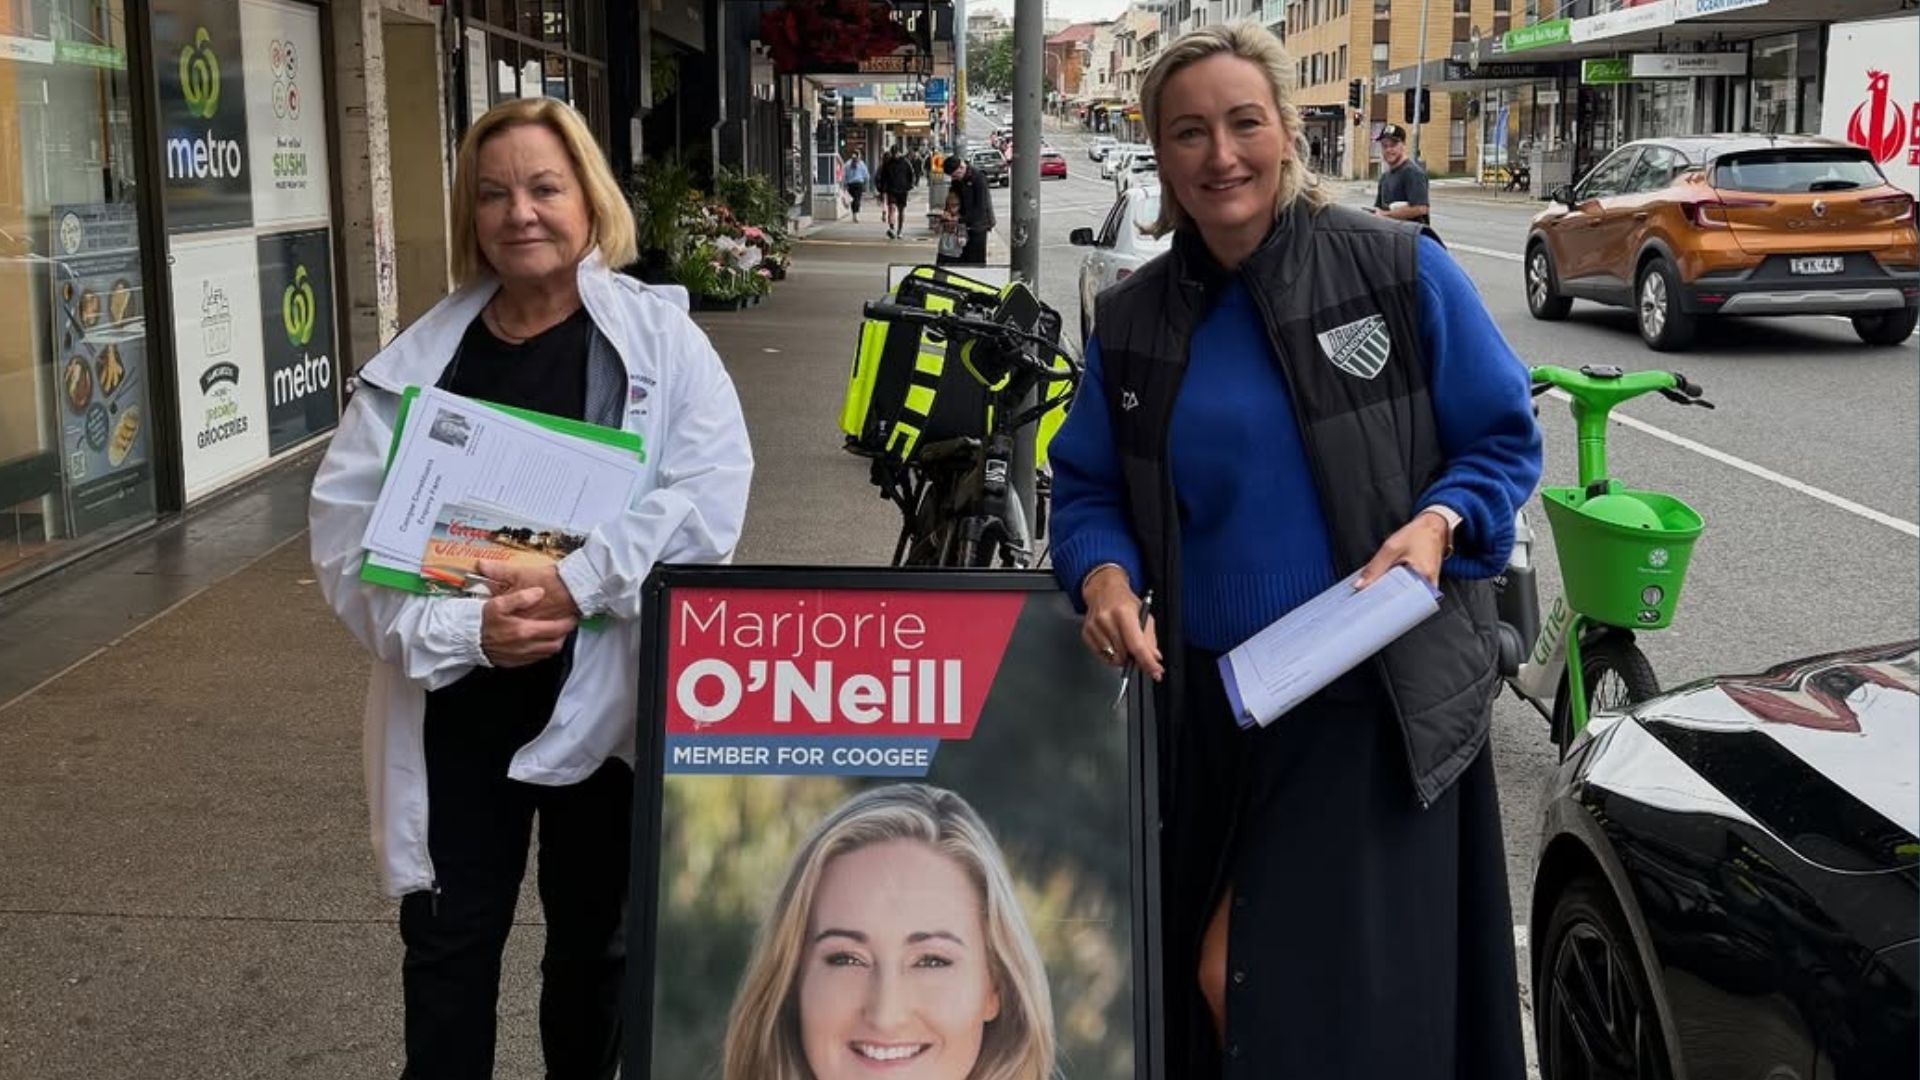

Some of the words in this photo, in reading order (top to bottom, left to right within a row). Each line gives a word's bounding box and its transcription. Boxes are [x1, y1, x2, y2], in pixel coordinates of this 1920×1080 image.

[167, 129, 241, 178] metro
[273, 152, 307, 177] SUSHI
[274, 353, 330, 406] metro
[198, 416, 248, 449] GROCERIES
[679, 600, 926, 657] Marjorie
[676, 657, 962, 724] O’Neill
[673, 746, 769, 765] MEMBER
[778, 747, 824, 766] FOR
[832, 747, 929, 767] COOGEE
